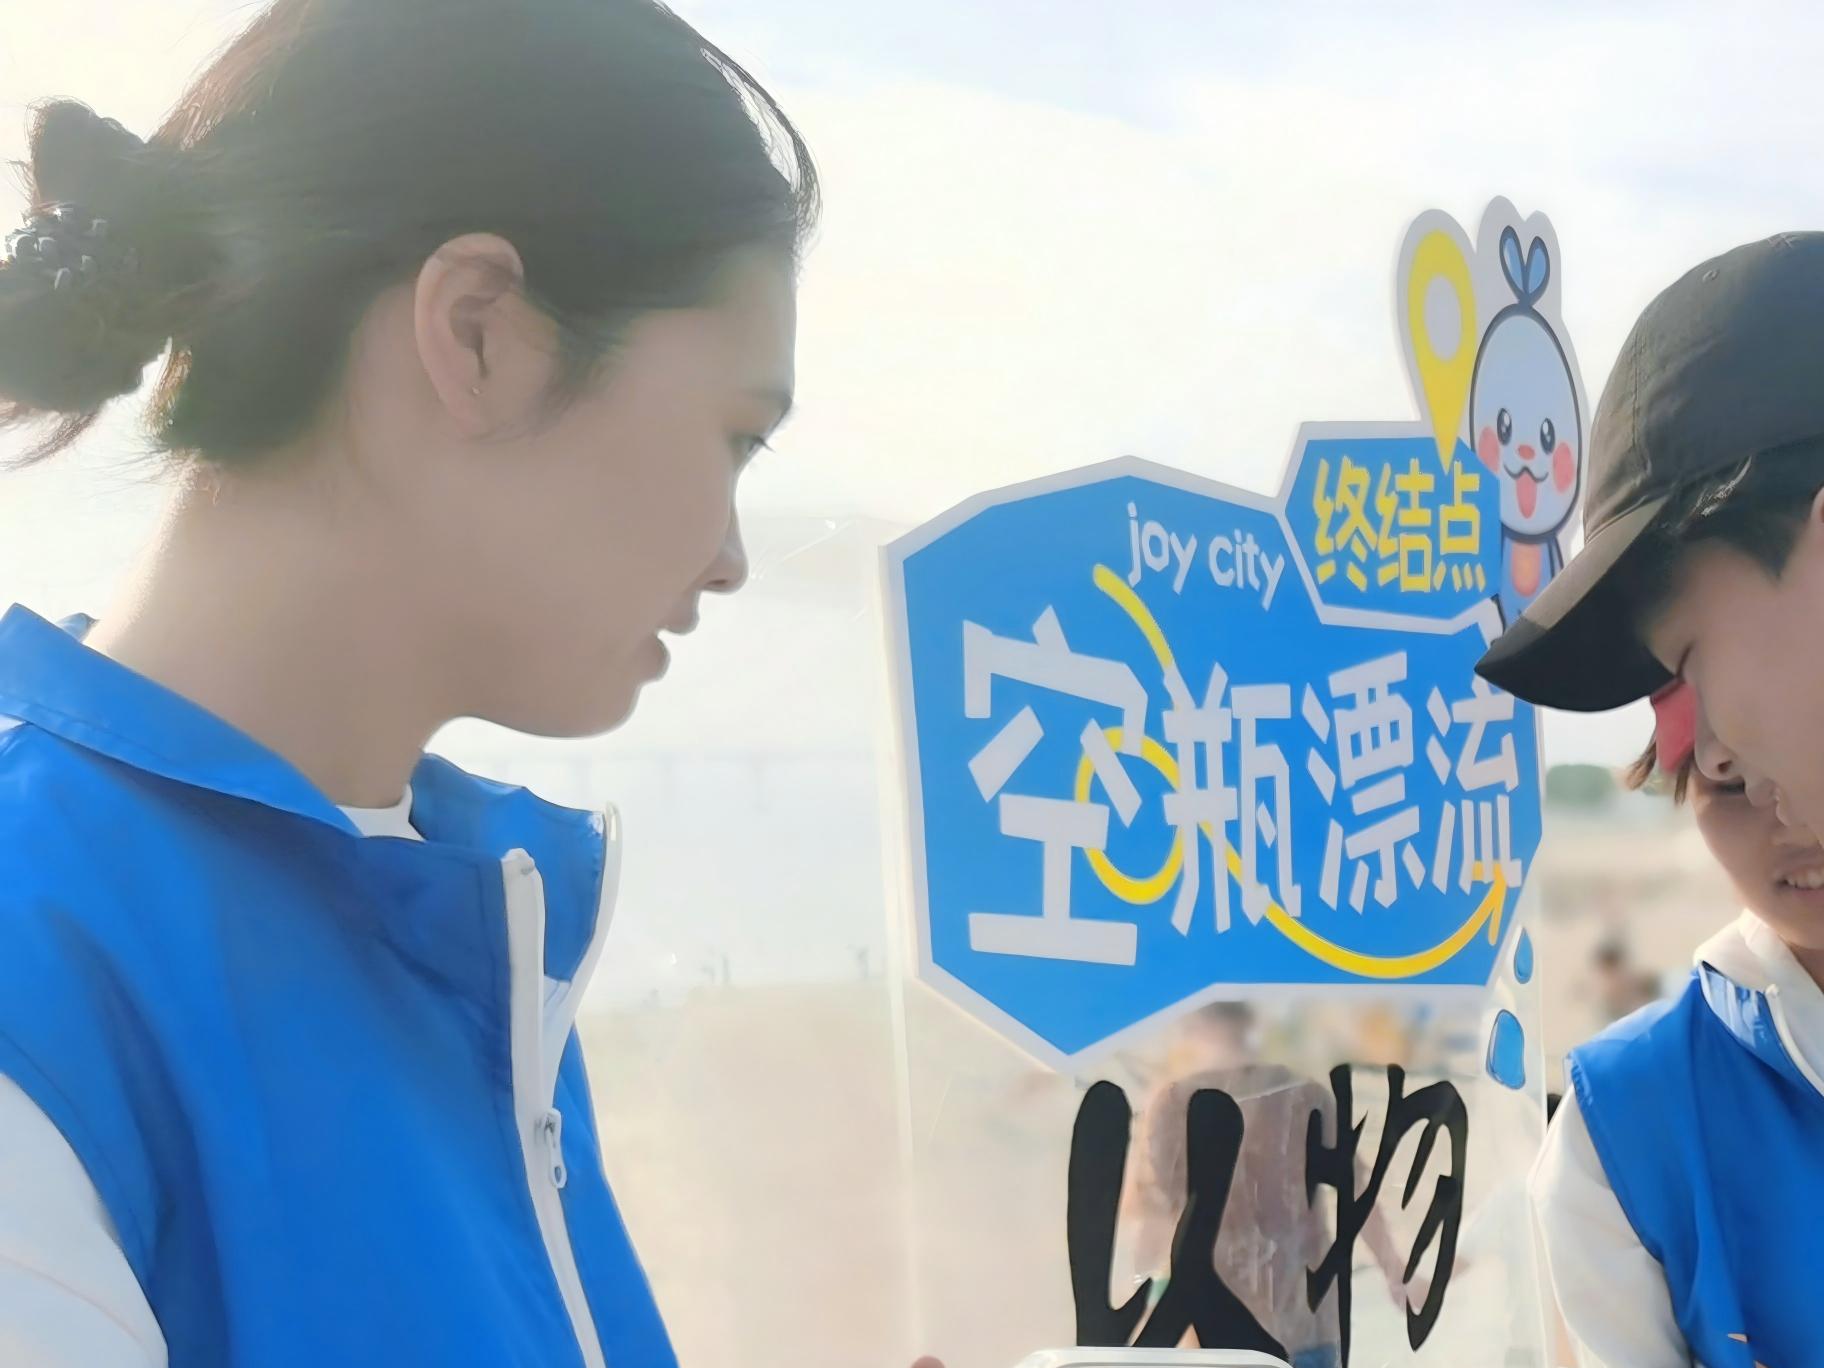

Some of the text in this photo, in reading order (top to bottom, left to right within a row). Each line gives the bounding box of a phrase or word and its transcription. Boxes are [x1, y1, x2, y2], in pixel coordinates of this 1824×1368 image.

[1125, 502, 1285, 611] joy city
[1312, 455, 1487, 593] 终结点
[962, 604, 1523, 967] 空瓶漂流
